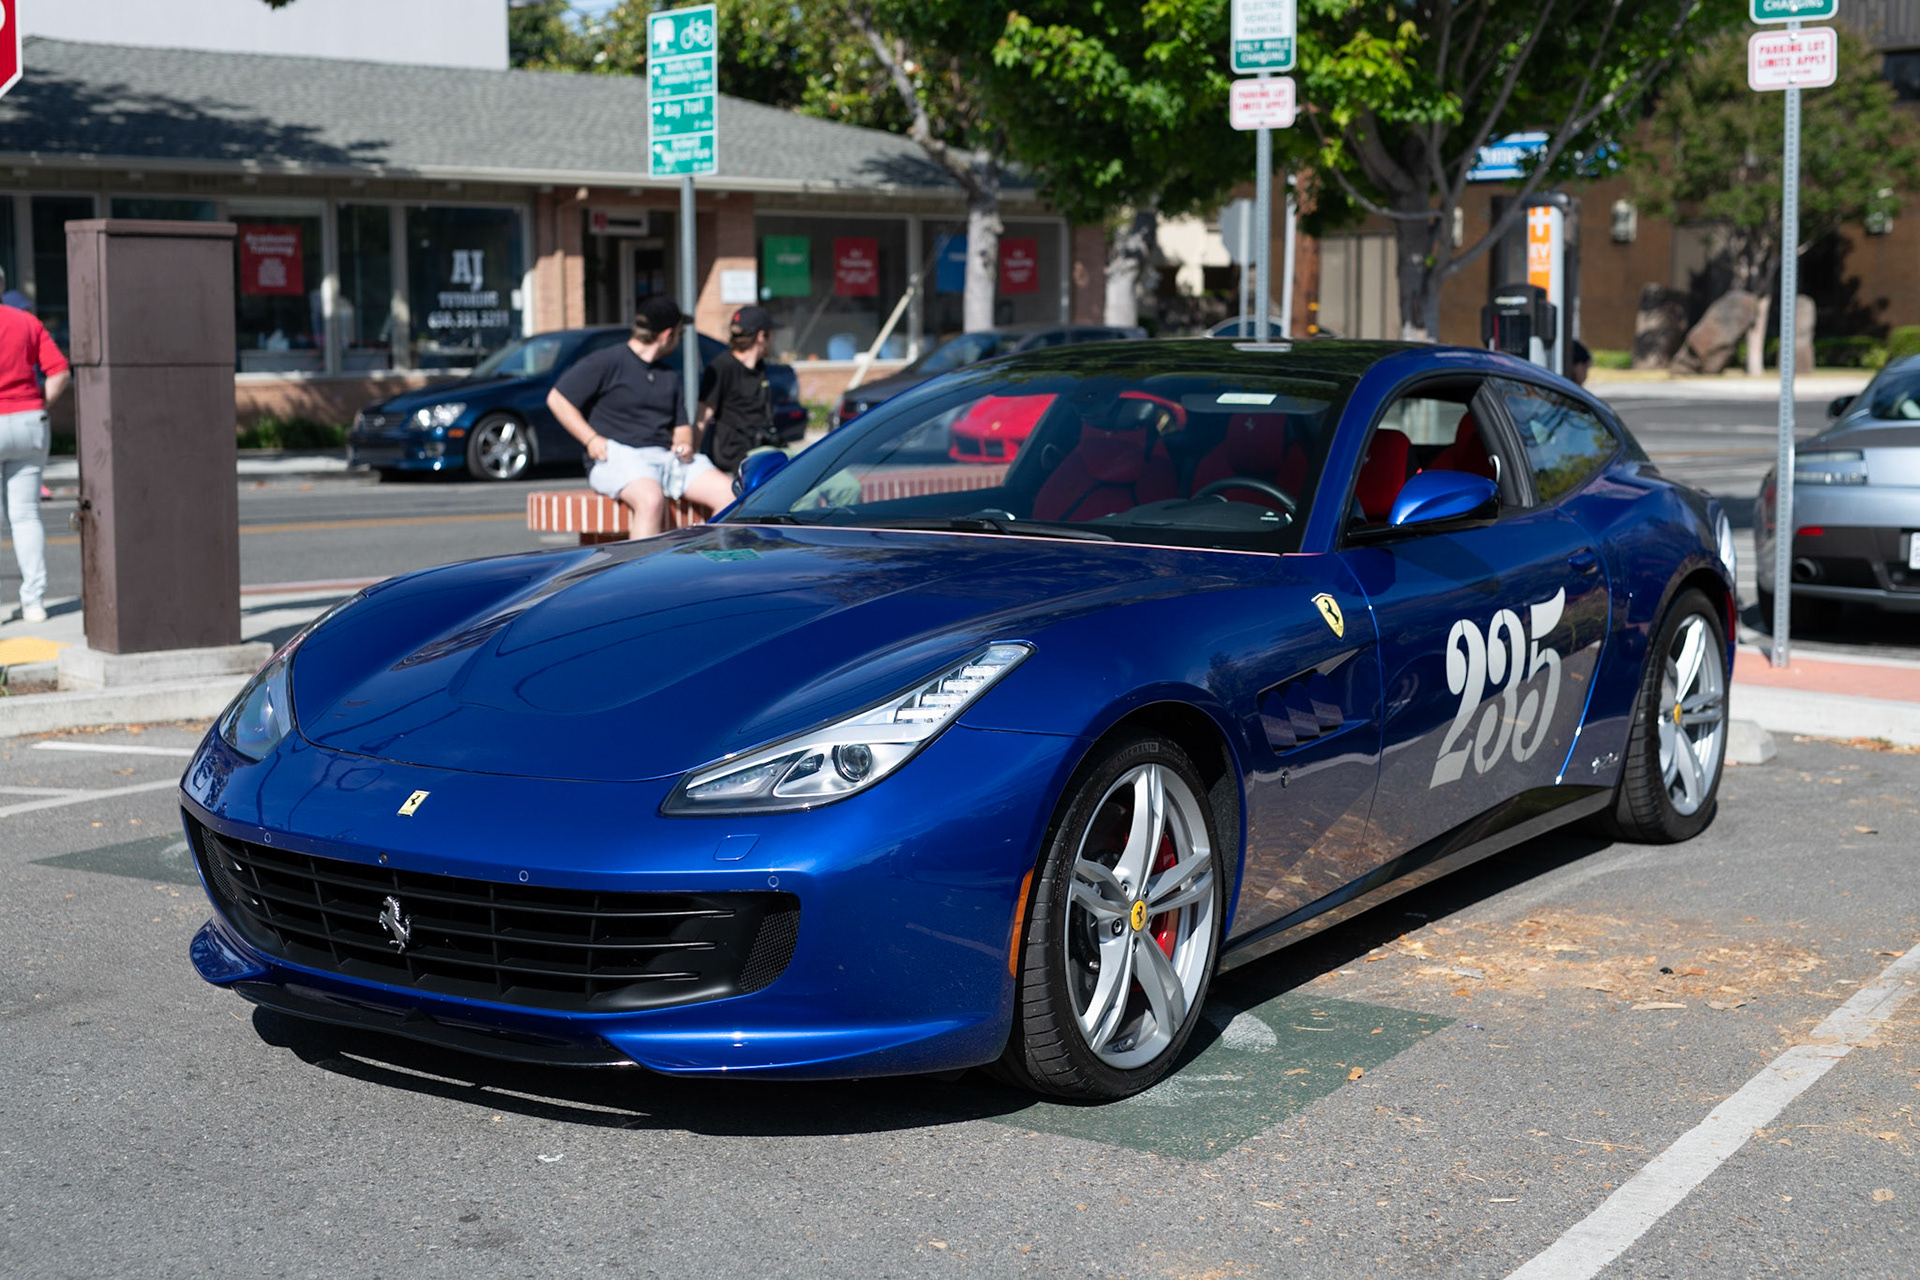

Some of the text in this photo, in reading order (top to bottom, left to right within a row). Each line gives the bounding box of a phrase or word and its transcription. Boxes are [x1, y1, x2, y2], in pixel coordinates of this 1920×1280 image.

[1758, 54, 1826, 69] LIMITS APPLY
[1760, 41, 1825, 54] PARKING LOT
[451, 250, 484, 291] AJ
[1430, 587, 1566, 788] 235
